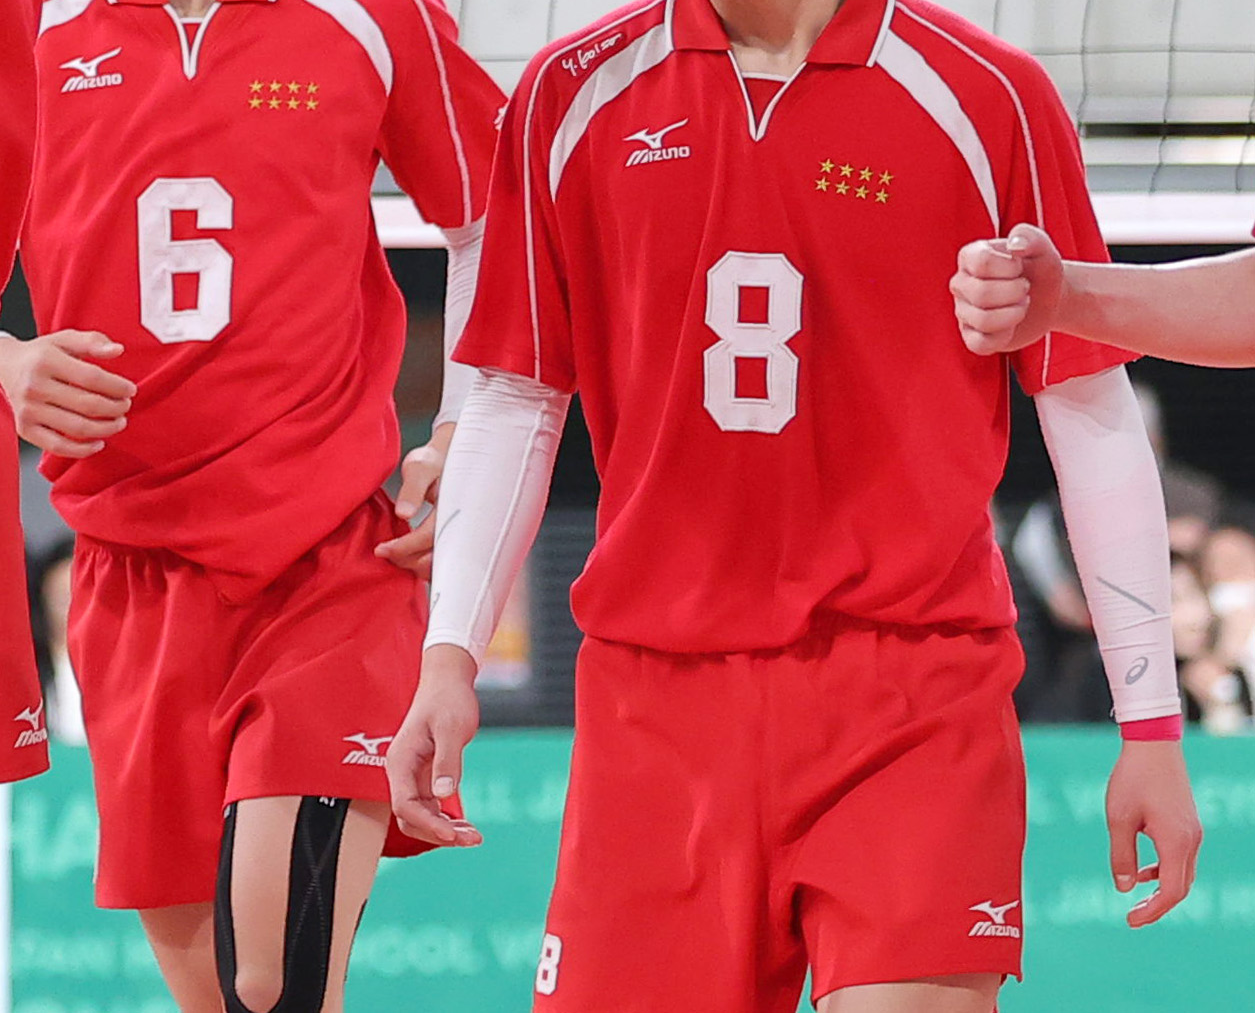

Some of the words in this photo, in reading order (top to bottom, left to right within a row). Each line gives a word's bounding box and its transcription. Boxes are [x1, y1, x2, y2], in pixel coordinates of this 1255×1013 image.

[61, 73, 123, 93] MIZUNO
[625, 146, 690, 166] MIZUNO
[137, 177, 233, 344] 6
[703, 250, 804, 434] 8
[968, 921, 1020, 938] MIZUNO
[535, 932, 563, 995] 8
